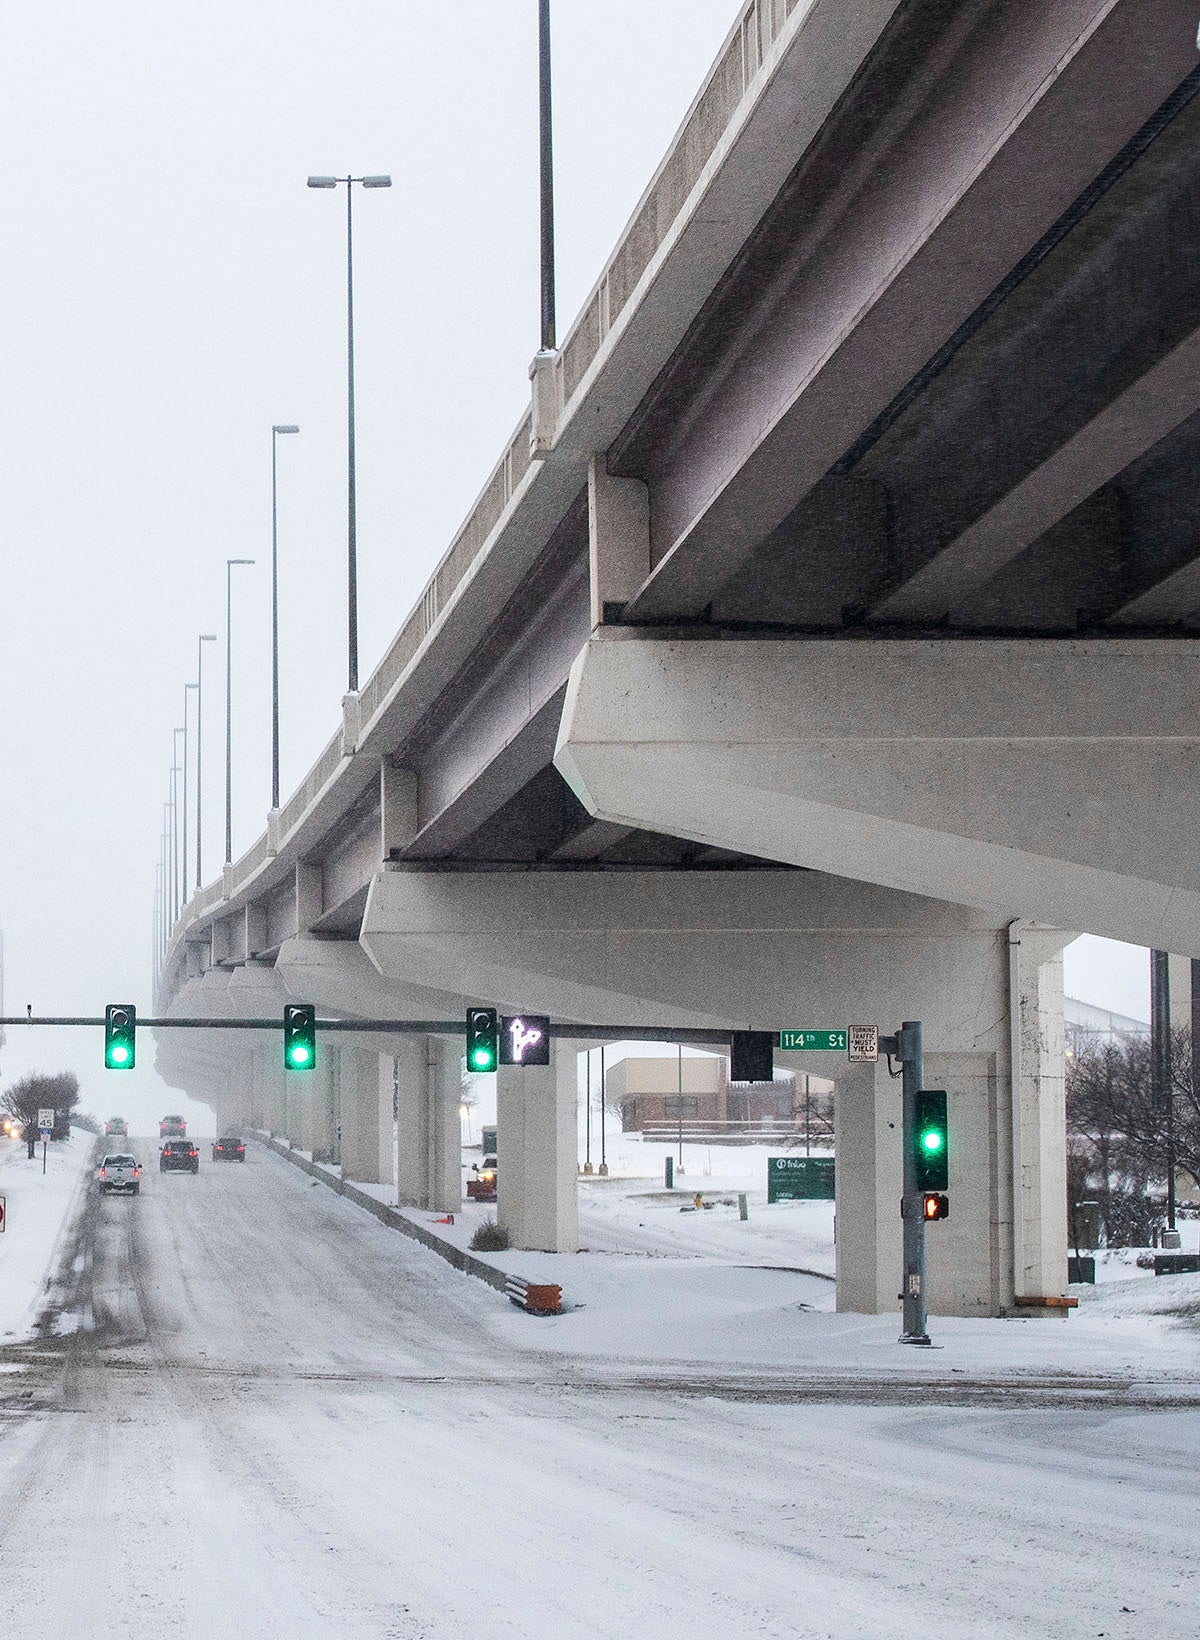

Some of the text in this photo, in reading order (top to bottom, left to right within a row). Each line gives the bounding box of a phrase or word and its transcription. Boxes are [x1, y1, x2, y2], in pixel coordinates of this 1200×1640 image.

[784, 1033, 844, 1047] 114th St
[39, 1119, 53, 1127] 45
